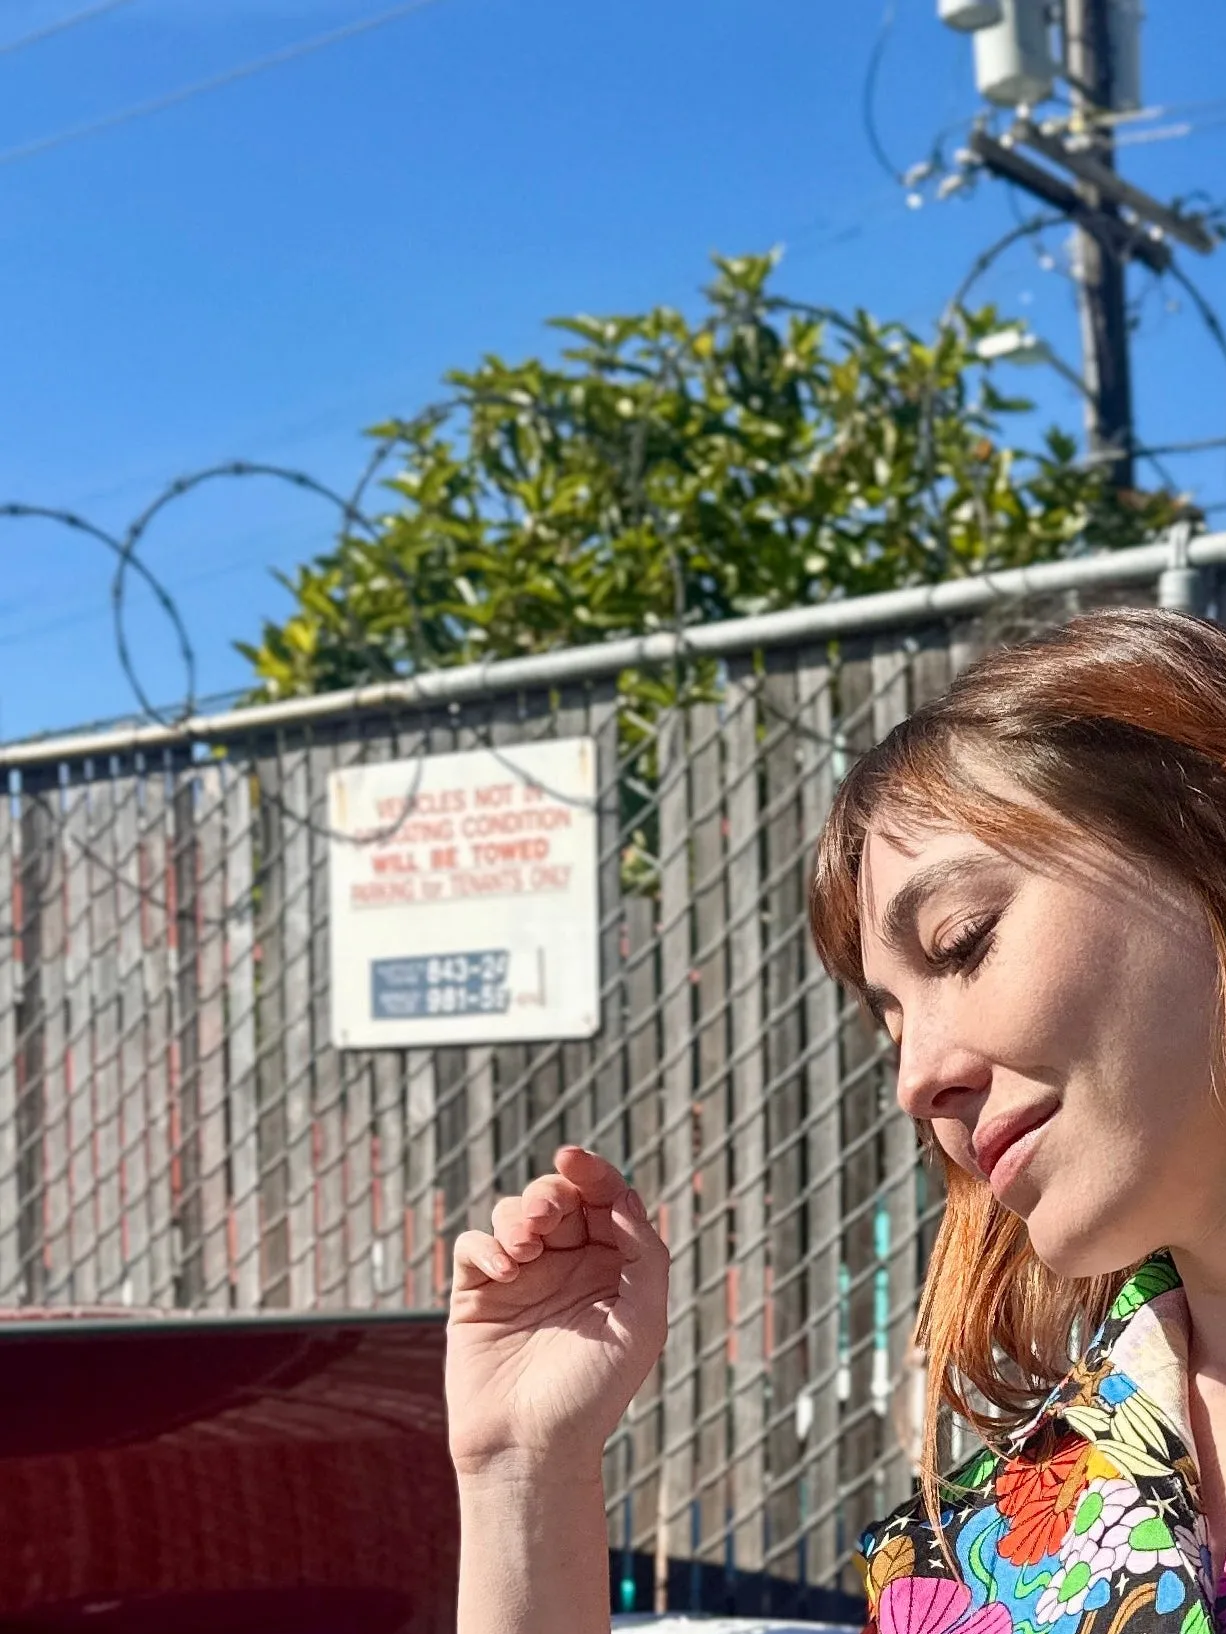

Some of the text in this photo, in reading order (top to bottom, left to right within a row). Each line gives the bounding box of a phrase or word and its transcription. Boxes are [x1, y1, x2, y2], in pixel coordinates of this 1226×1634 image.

[377, 789, 466, 818] VECLES
[474, 783, 514, 806] NOT
[354, 807, 572, 850] ATING CONDITION
[371, 837, 550, 875] WILL BE TOWED
